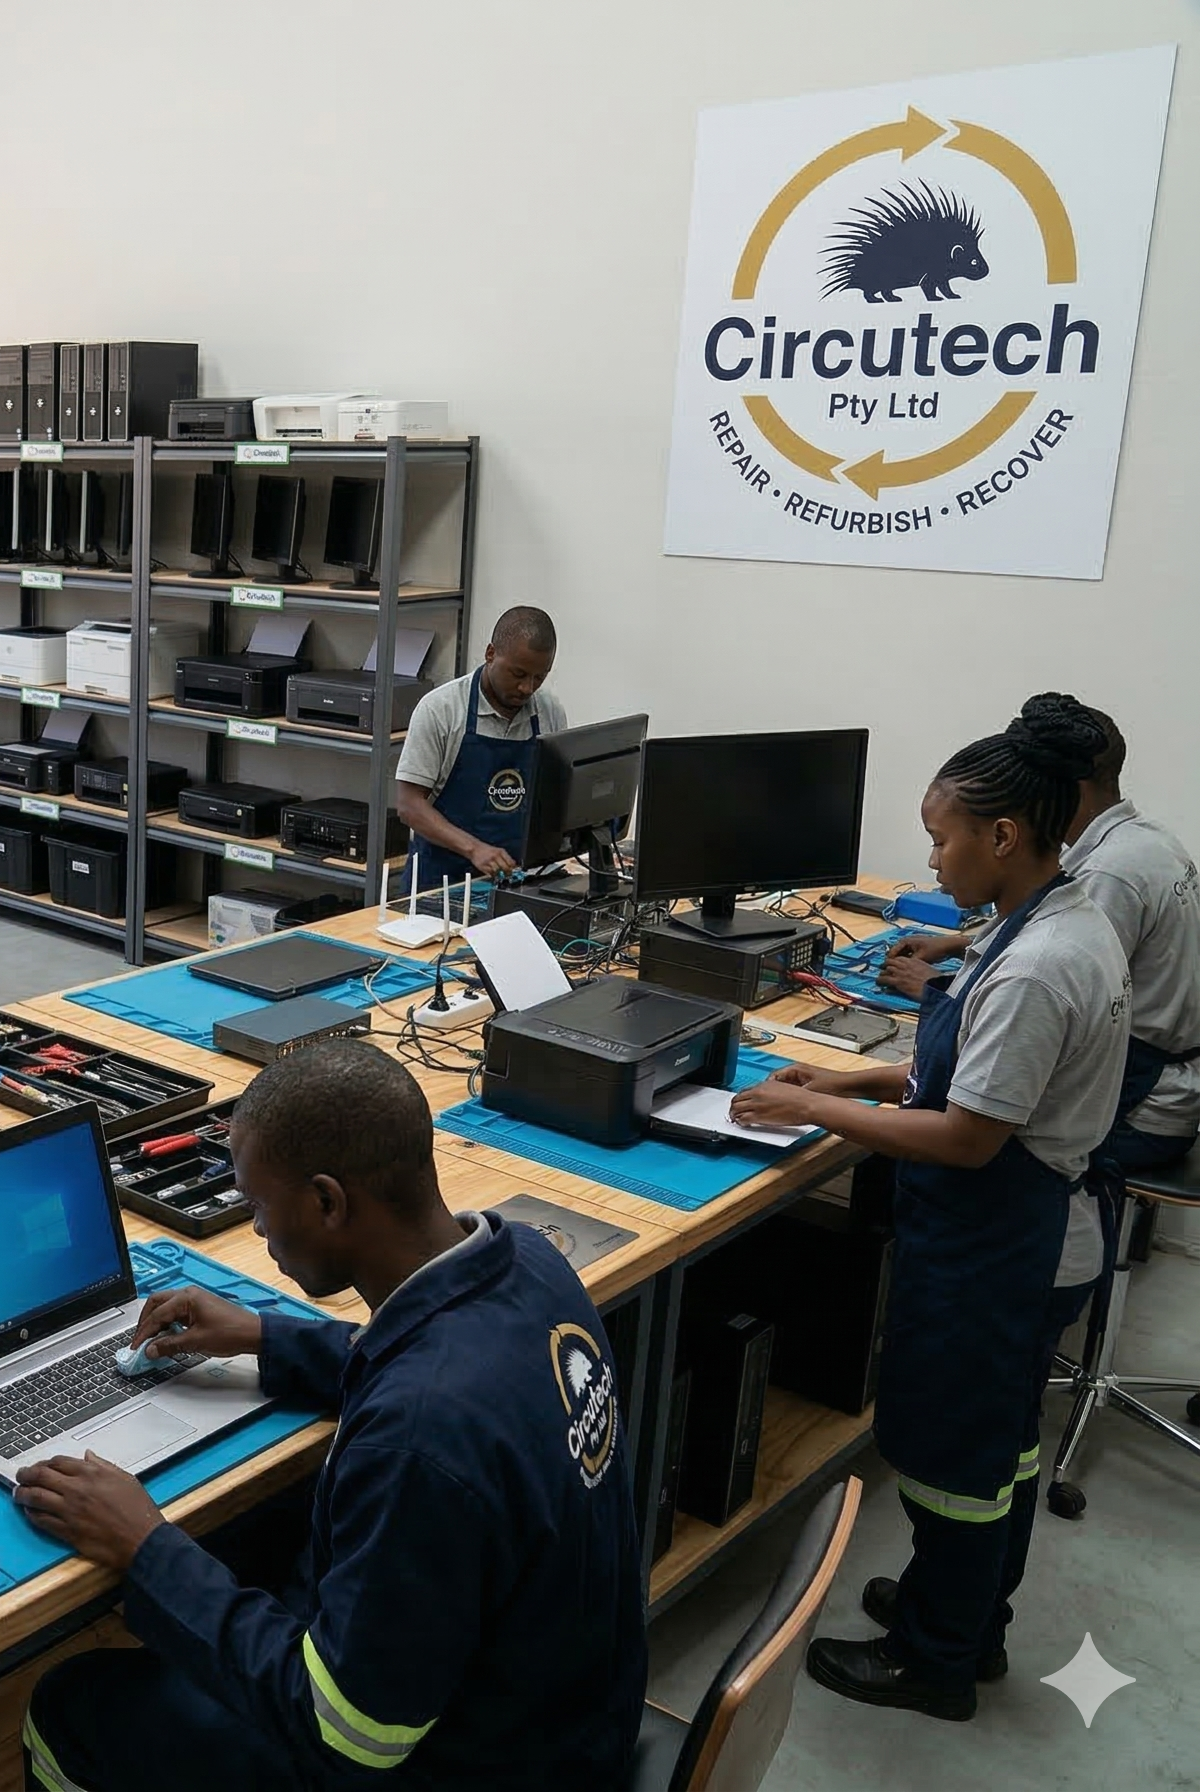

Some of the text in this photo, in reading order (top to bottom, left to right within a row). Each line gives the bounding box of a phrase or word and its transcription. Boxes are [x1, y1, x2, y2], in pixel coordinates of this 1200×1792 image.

[704, 303, 1099, 381] Circutech
[828, 391, 939, 424] Pty Ltd
[709, 407, 1074, 534] REPAIR REFURBISH RECOVER
